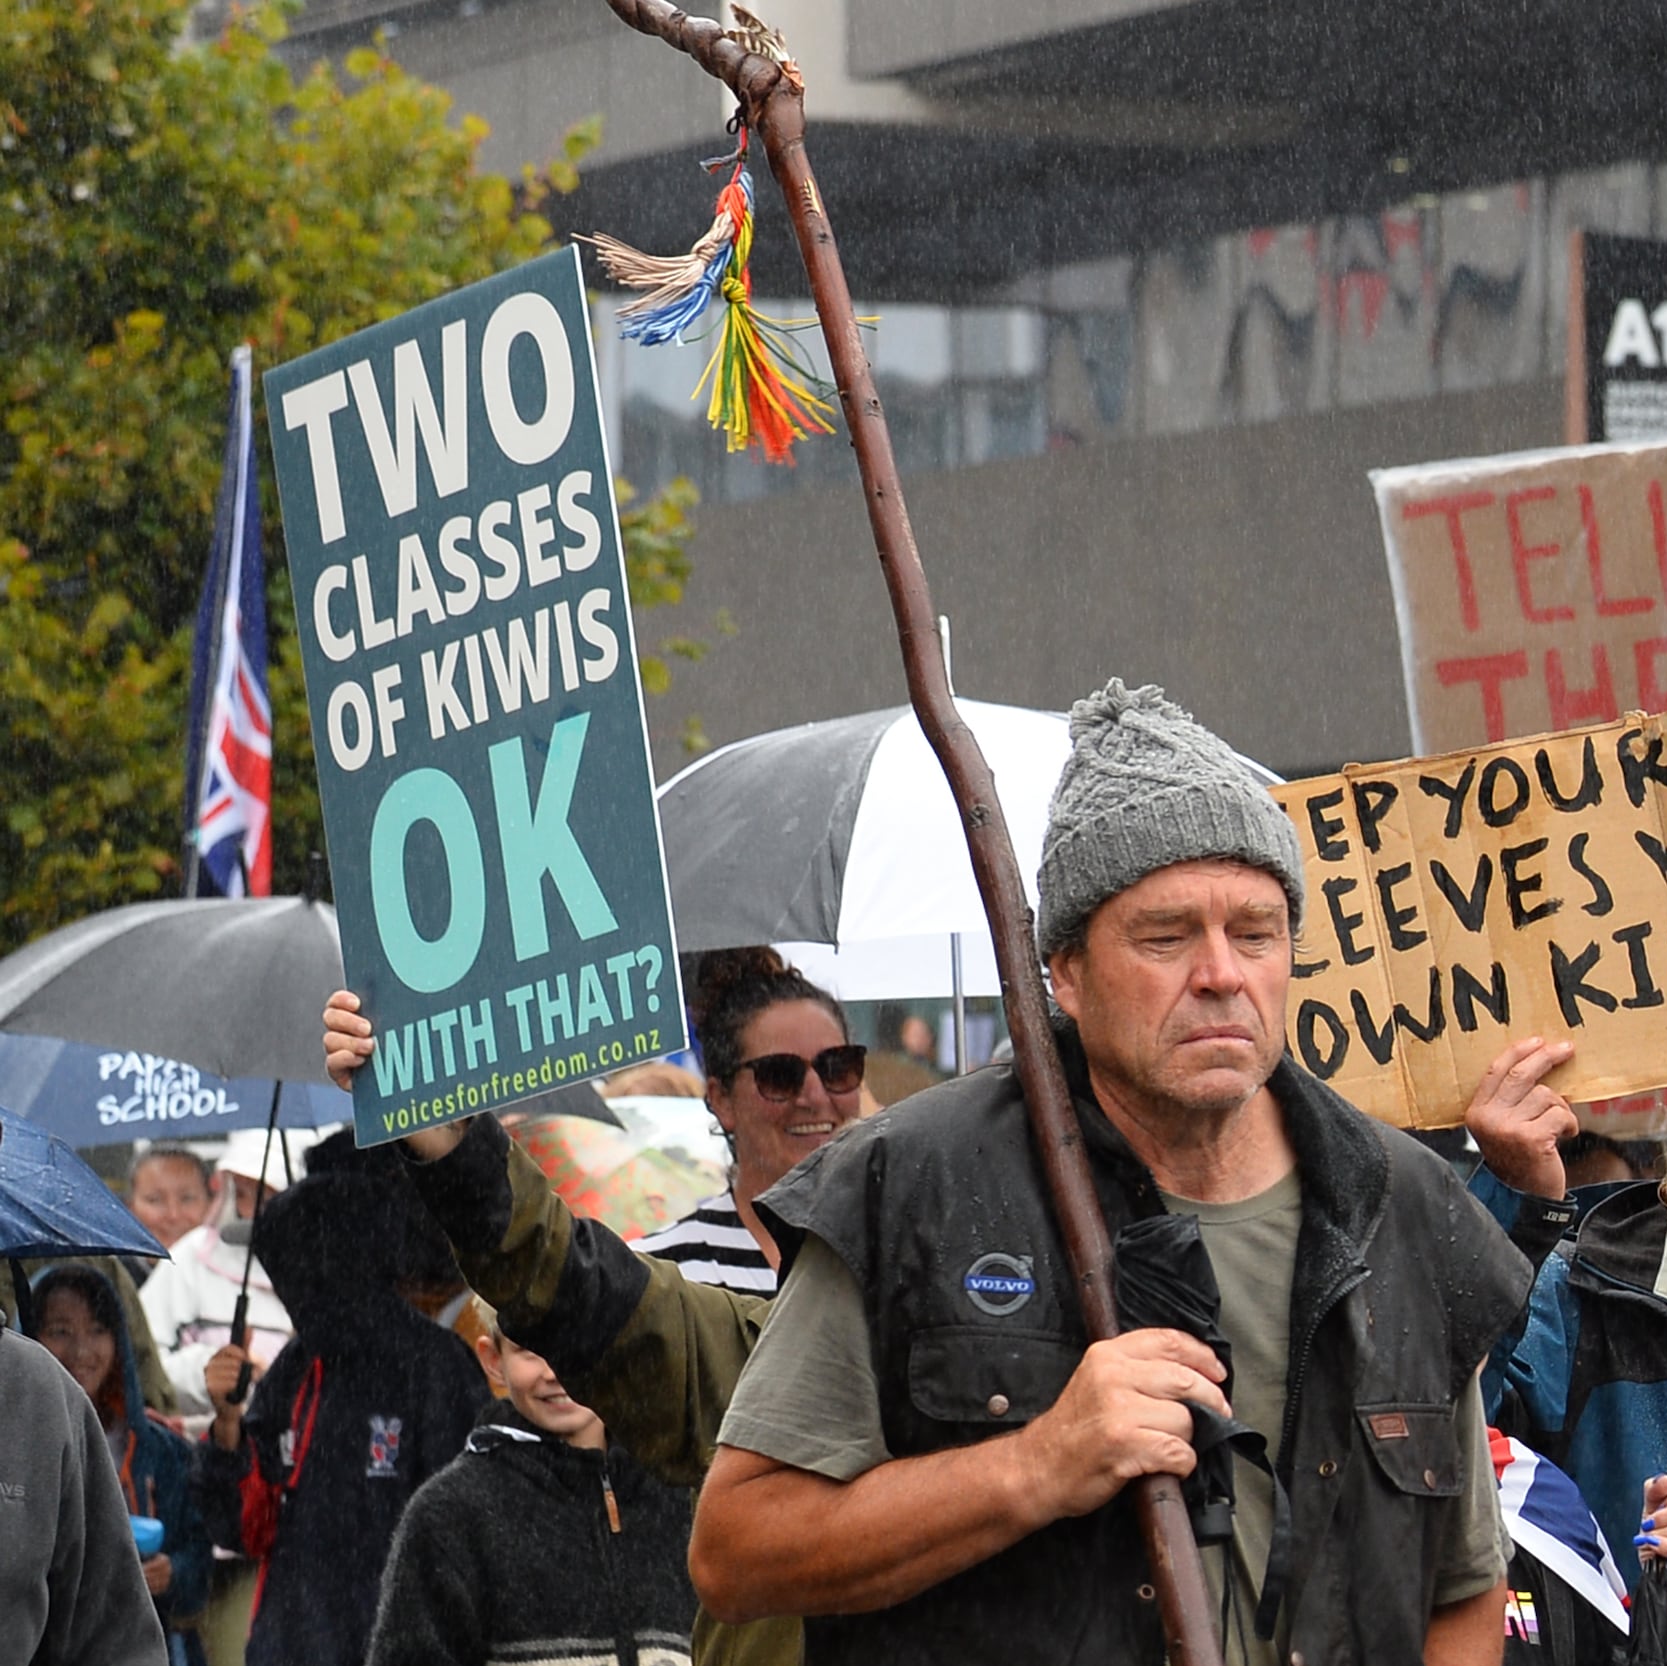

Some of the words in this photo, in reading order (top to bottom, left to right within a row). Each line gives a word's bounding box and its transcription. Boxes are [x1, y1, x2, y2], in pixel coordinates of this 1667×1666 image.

[282, 292, 577, 545] TWO
[311, 470, 604, 662] CLASSES
[326, 663, 403, 772] OF
[421, 587, 621, 740] KIWIS
[370, 711, 620, 994] OK
[1306, 781, 1399, 861] EP
[371, 998, 498, 1099] WITH
[505, 944, 664, 1054] THAT?
[382, 1028, 662, 1134] voicesforfreedom.co.nz
[1297, 964, 1509, 1080] OWN
[96, 1088, 240, 1126] SCHOOL
[970, 1278, 1030, 1292] VOLVO
